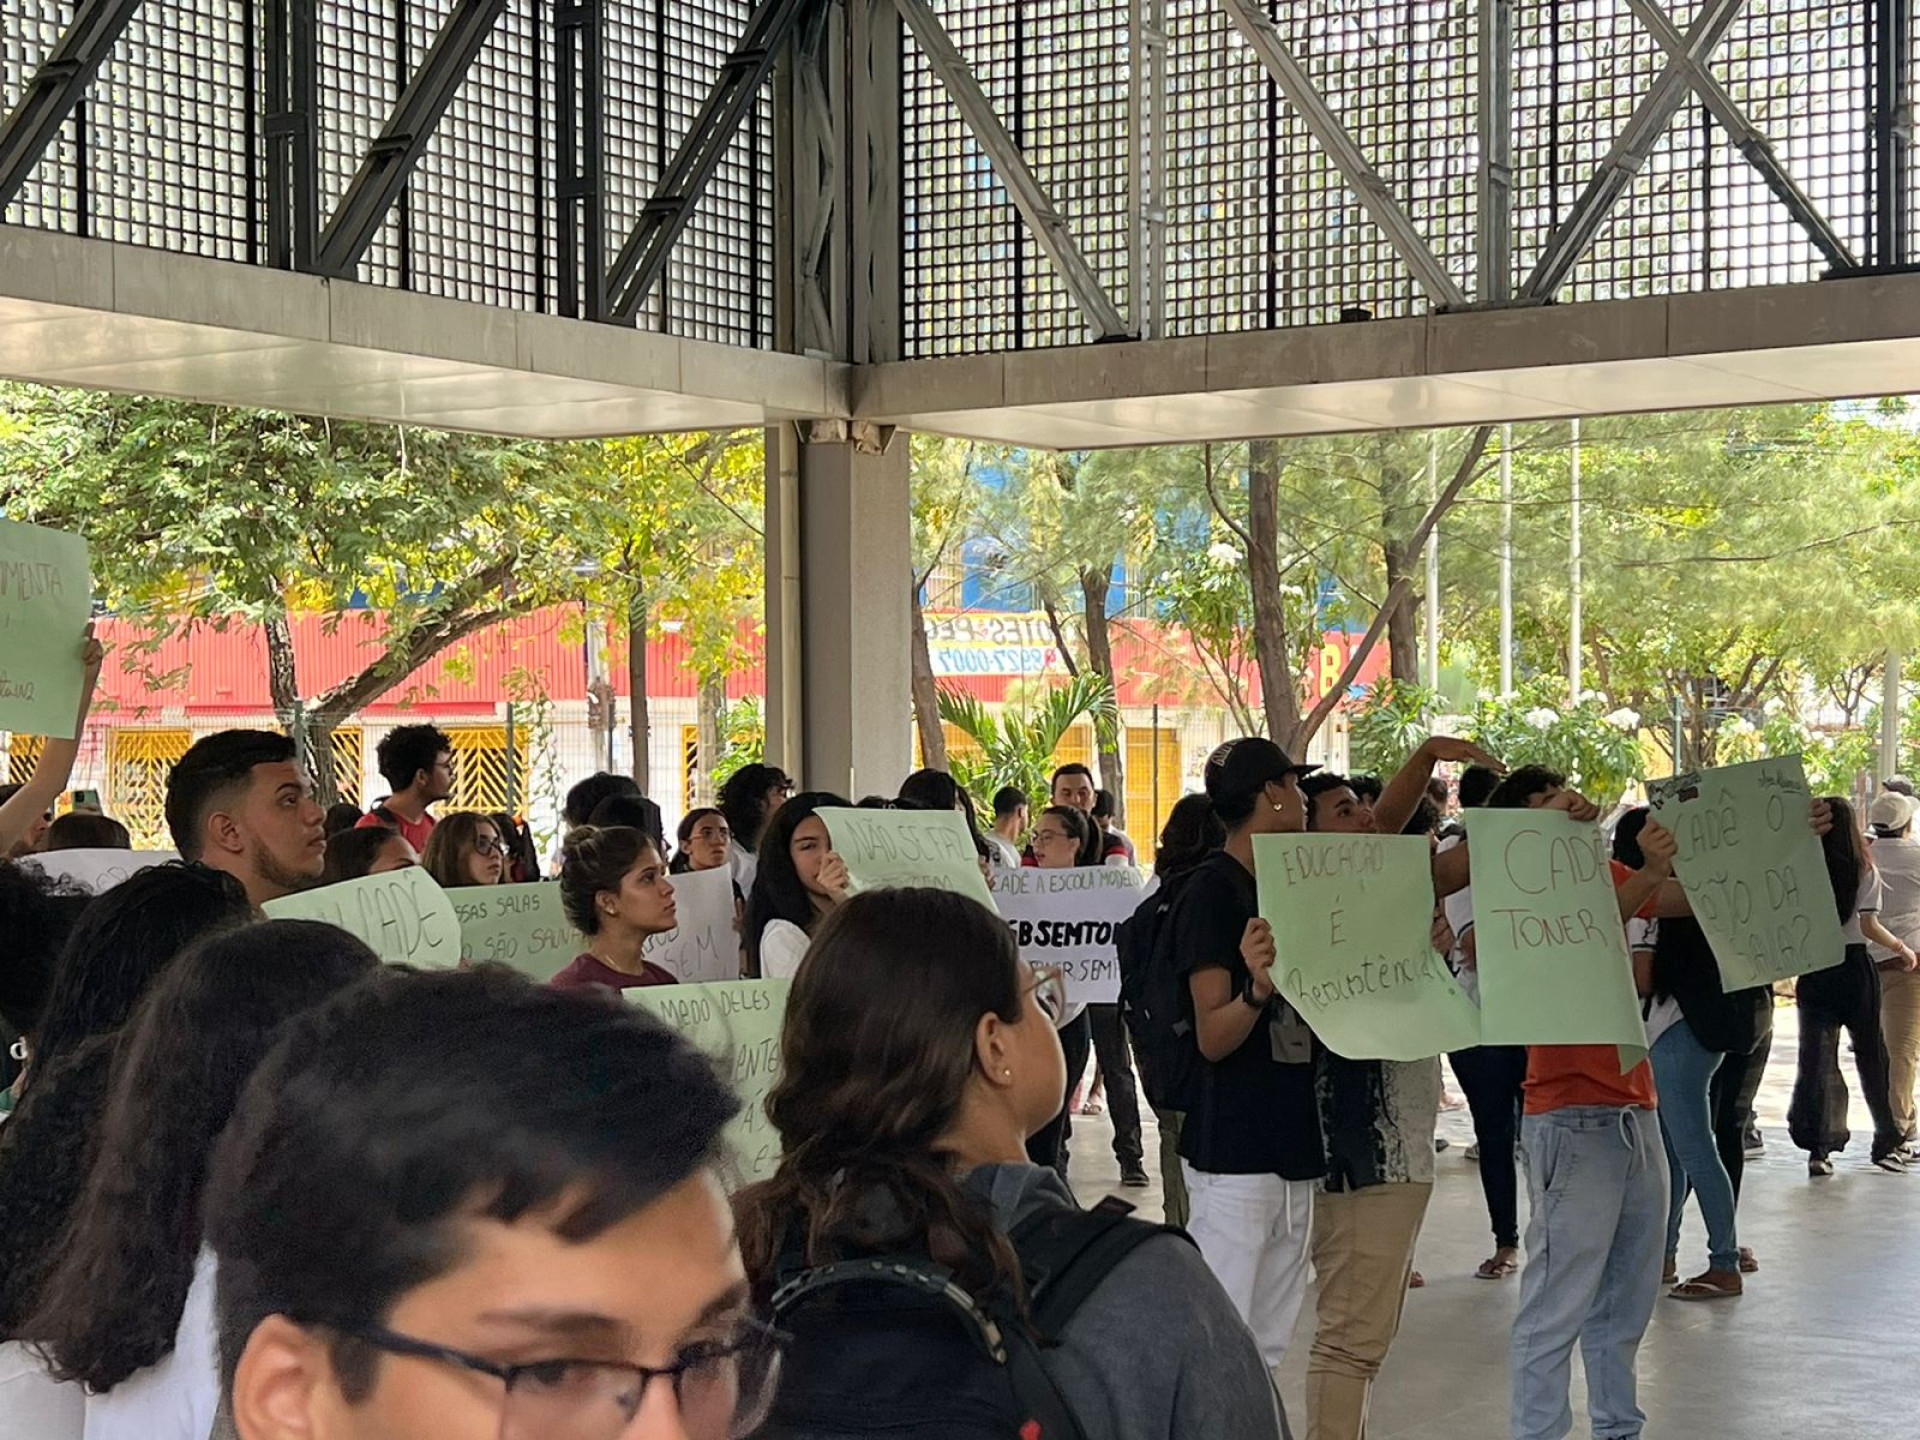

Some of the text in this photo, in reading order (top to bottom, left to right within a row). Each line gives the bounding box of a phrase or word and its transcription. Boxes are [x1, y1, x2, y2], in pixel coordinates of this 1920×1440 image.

[1766, 794, 1784, 832] O
[1283, 836, 1384, 891] EDUCAÇÃO
[1050, 872, 1095, 893] ESCOLA
[1765, 865, 1798, 910] DA
[496, 894, 541, 917] SALAS
[1330, 895, 1347, 946] É
[485, 931, 518, 960] SÃO
[720, 989, 771, 1016] DELES
